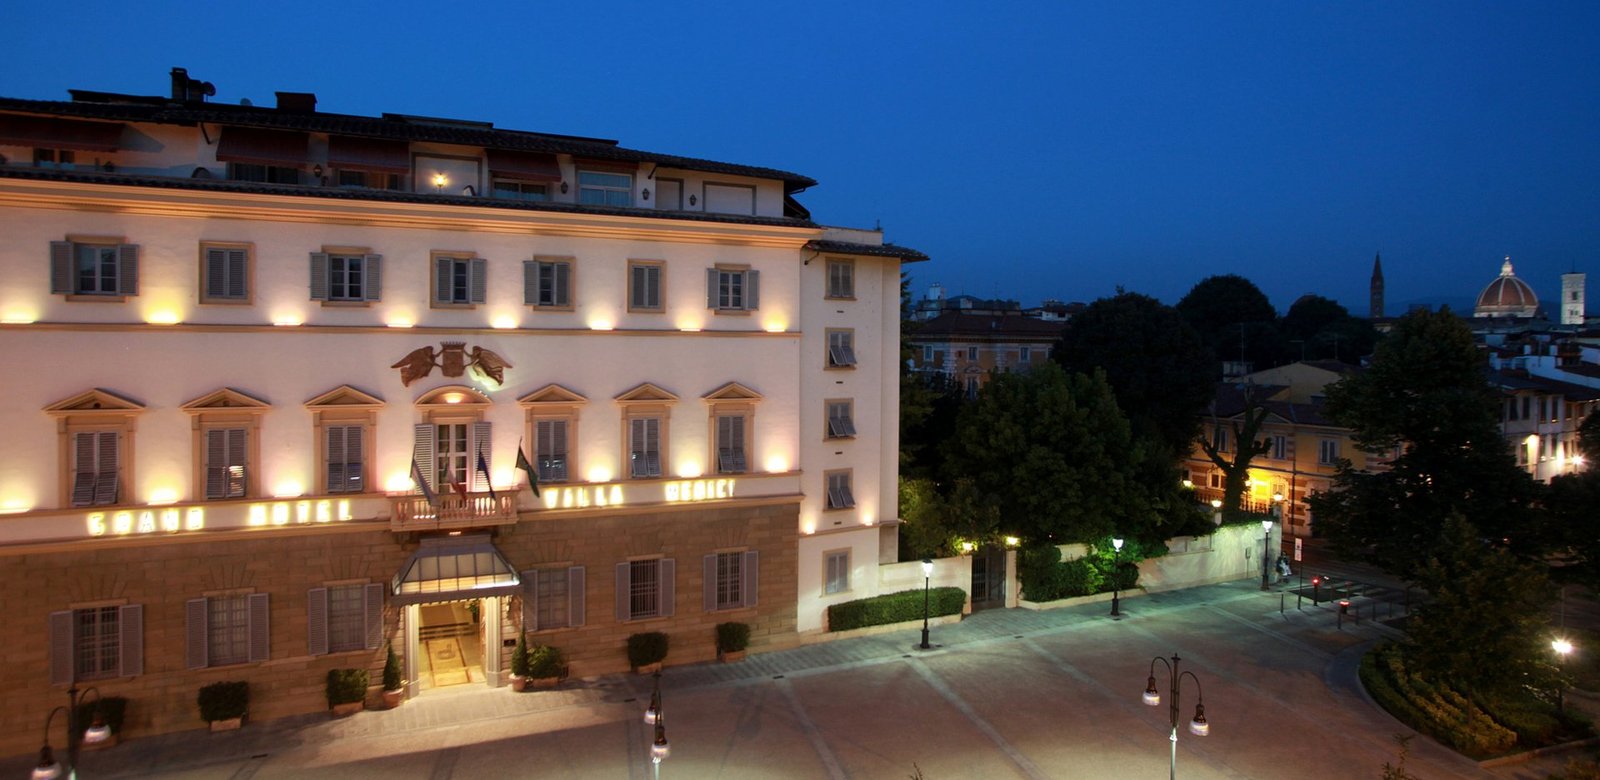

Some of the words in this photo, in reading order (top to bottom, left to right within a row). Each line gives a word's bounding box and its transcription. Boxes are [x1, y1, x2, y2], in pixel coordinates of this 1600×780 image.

[544, 485, 624, 508] VILLA
[665, 479, 735, 501] MEDICI
[87, 506, 204, 536] GRAND
[249, 499, 352, 526] HOTEL
